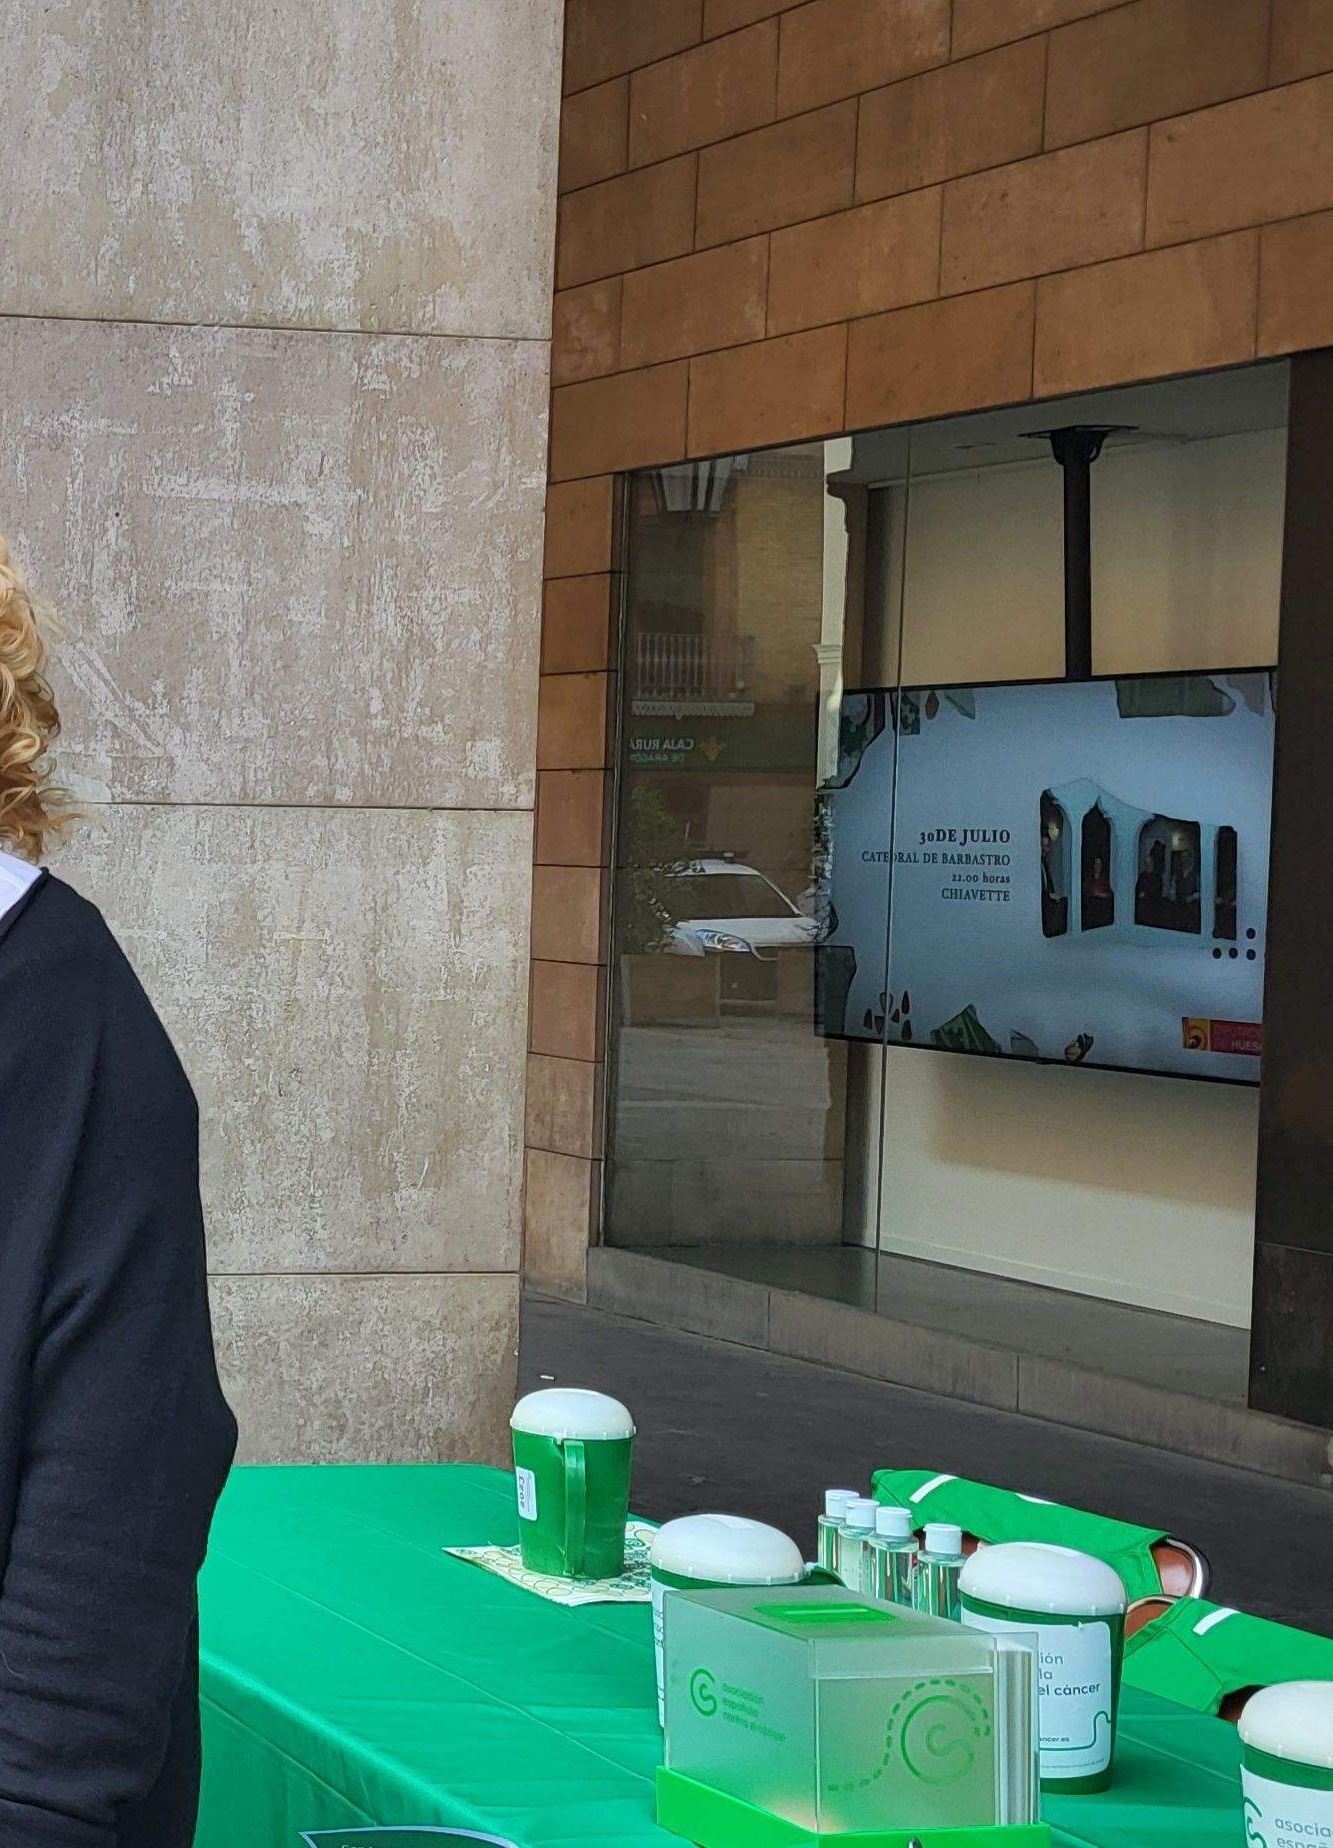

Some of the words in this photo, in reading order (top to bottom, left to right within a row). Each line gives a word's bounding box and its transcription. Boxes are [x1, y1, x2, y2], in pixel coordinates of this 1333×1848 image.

[959, 829, 1011, 847] JULIO
[923, 853, 938, 864] DE
[941, 853, 1011, 866] BARBASTRO
[982, 871, 1011, 884] horas
[941, 888, 1011, 902] CHIAVETTE
[1053, 1682, 1101, 1697] cáncer
[1275, 1818, 1333, 1838] asocia
